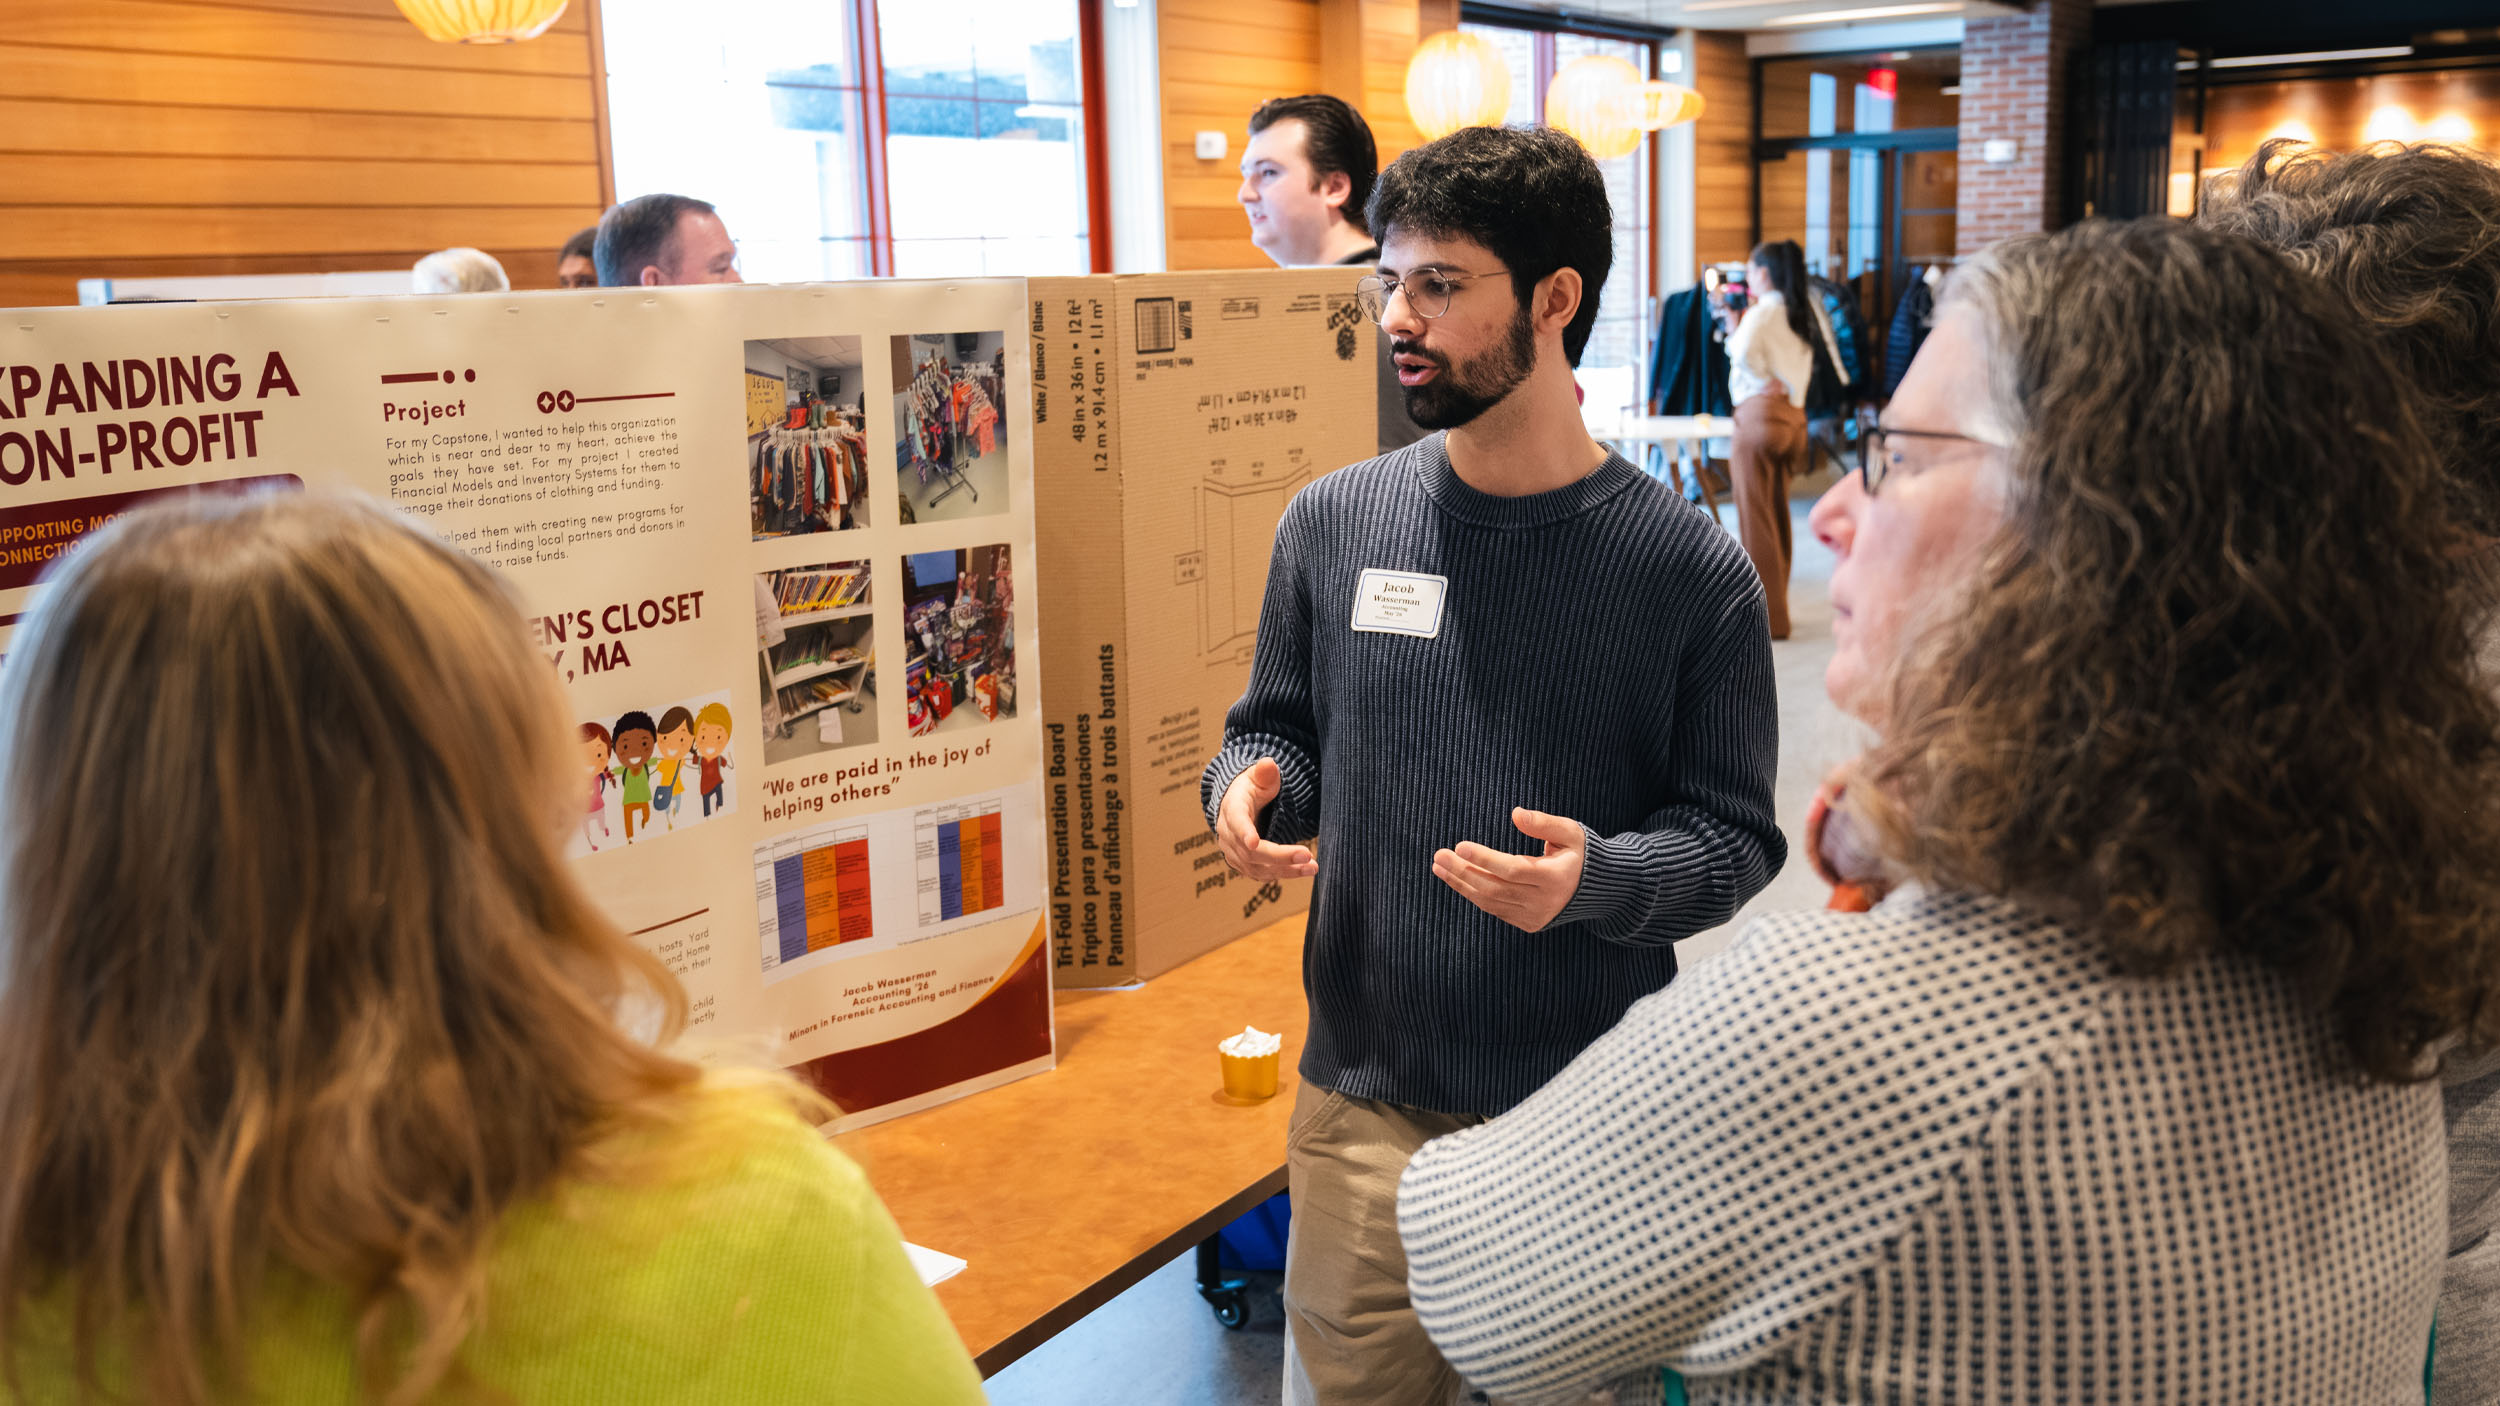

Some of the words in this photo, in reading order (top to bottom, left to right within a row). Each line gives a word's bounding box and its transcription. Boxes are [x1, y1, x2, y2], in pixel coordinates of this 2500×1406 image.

[1032, 300, 1044, 333] Blanc
[256, 351, 301, 399] A
[1034, 342, 1046, 381] Blanco
[383, 400, 466, 426] Project
[1036, 391, 1047, 425] White
[1075, 394, 1085, 405] x
[386, 438, 406, 449] For
[411, 438, 428, 450] my
[432, 433, 492, 447] Capstone,
[502, 425, 543, 440] wanted
[546, 427, 558, 436] to
[562, 422, 585, 435] help
[588, 421, 607, 431] this
[611, 417, 676, 432] organization
[1097, 420, 1107, 430] x
[388, 452, 425, 466] which
[431, 452, 441, 462] is
[448, 450, 474, 461] near
[480, 444, 501, 458] and
[508, 443, 533, 455] dear
[539, 443, 550, 452] to
[557, 442, 571, 452] my
[577, 437, 609, 449] heart,
[615, 433, 655, 445] achieve
[661, 430, 678, 441] the
[389, 468, 424, 486] goals
[433, 466, 459, 480] they
[468, 463, 494, 475] have
[503, 461, 524, 472] set.
[532, 457, 549, 469] For
[558, 457, 573, 468] my
[581, 451, 619, 466] project
[638, 444, 679, 458] created
[391, 481, 448, 499] Financial
[452, 478, 493, 493] Models
[497, 475, 518, 489] and
[522, 472, 571, 486] Inventory
[575, 467, 617, 482] Systems
[621, 464, 636, 474] for
[641, 460, 666, 473] them
[670, 461, 681, 470] to
[447, 497, 474, 510] their
[478, 491, 532, 507] donations
[535, 487, 546, 500] of
[550, 485, 594, 497] clothing
[597, 481, 617, 493] and
[620, 477, 664, 490] funding.
[0, 518, 84, 544] PPORTING
[470, 541, 492, 556] and
[496, 539, 534, 552] finding
[537, 532, 564, 547] local
[568, 528, 613, 546] partners
[616, 523, 636, 536] and
[639, 521, 673, 534] donors
[676, 519, 685, 529] in
[481, 525, 509, 538] them
[514, 520, 537, 534] with
[541, 517, 586, 530] creating
[591, 514, 613, 524] new
[617, 507, 666, 524] programs
[670, 503, 684, 514] for
[491, 559, 502, 569] to
[506, 554, 533, 567] raise
[536, 548, 569, 562] funds.
[1374, 594, 1420, 606] Wasserman
[1383, 581, 1415, 594] Jacob
[601, 590, 704, 634] CLOSET
[583, 640, 632, 675] MA
[1098, 643, 1117, 720] battants
[800, 772, 829, 788] are
[835, 758, 879, 786] paid
[886, 758, 902, 773] in
[908, 751, 937, 769] the
[943, 747, 969, 768] joy
[975, 738, 992, 756] of
[1046, 722, 1067, 778] Board
[1101, 725, 1118, 766] trois
[1076, 712, 1097, 852] presentaciones
[1104, 771, 1119, 784] à
[763, 796, 824, 822] helping
[1050, 783, 1071, 899] Presentation
[1102, 788, 1125, 885] d'affichage
[1081, 857, 1102, 899] para
[659, 940, 683, 954] hosts
[689, 928, 709, 942] Yard
[1053, 903, 1074, 969] Tri-Fold
[1106, 888, 1125, 968] Panneau
[665, 953, 682, 966] and
[687, 943, 710, 958] Home
[692, 957, 711, 970] their
[843, 984, 874, 997] Jacob
[877, 969, 937, 988] Wasserman
[852, 987, 911, 1007] Accounting
[693, 995, 714, 1012] child
[789, 1024, 818, 1041] Minors
[820, 1019, 829, 1028] in
[831, 1007, 875, 1025] Forensic
[879, 992, 936, 1012] Accounting
[939, 986, 957, 997] and
[960, 975, 994, 992] Finance
